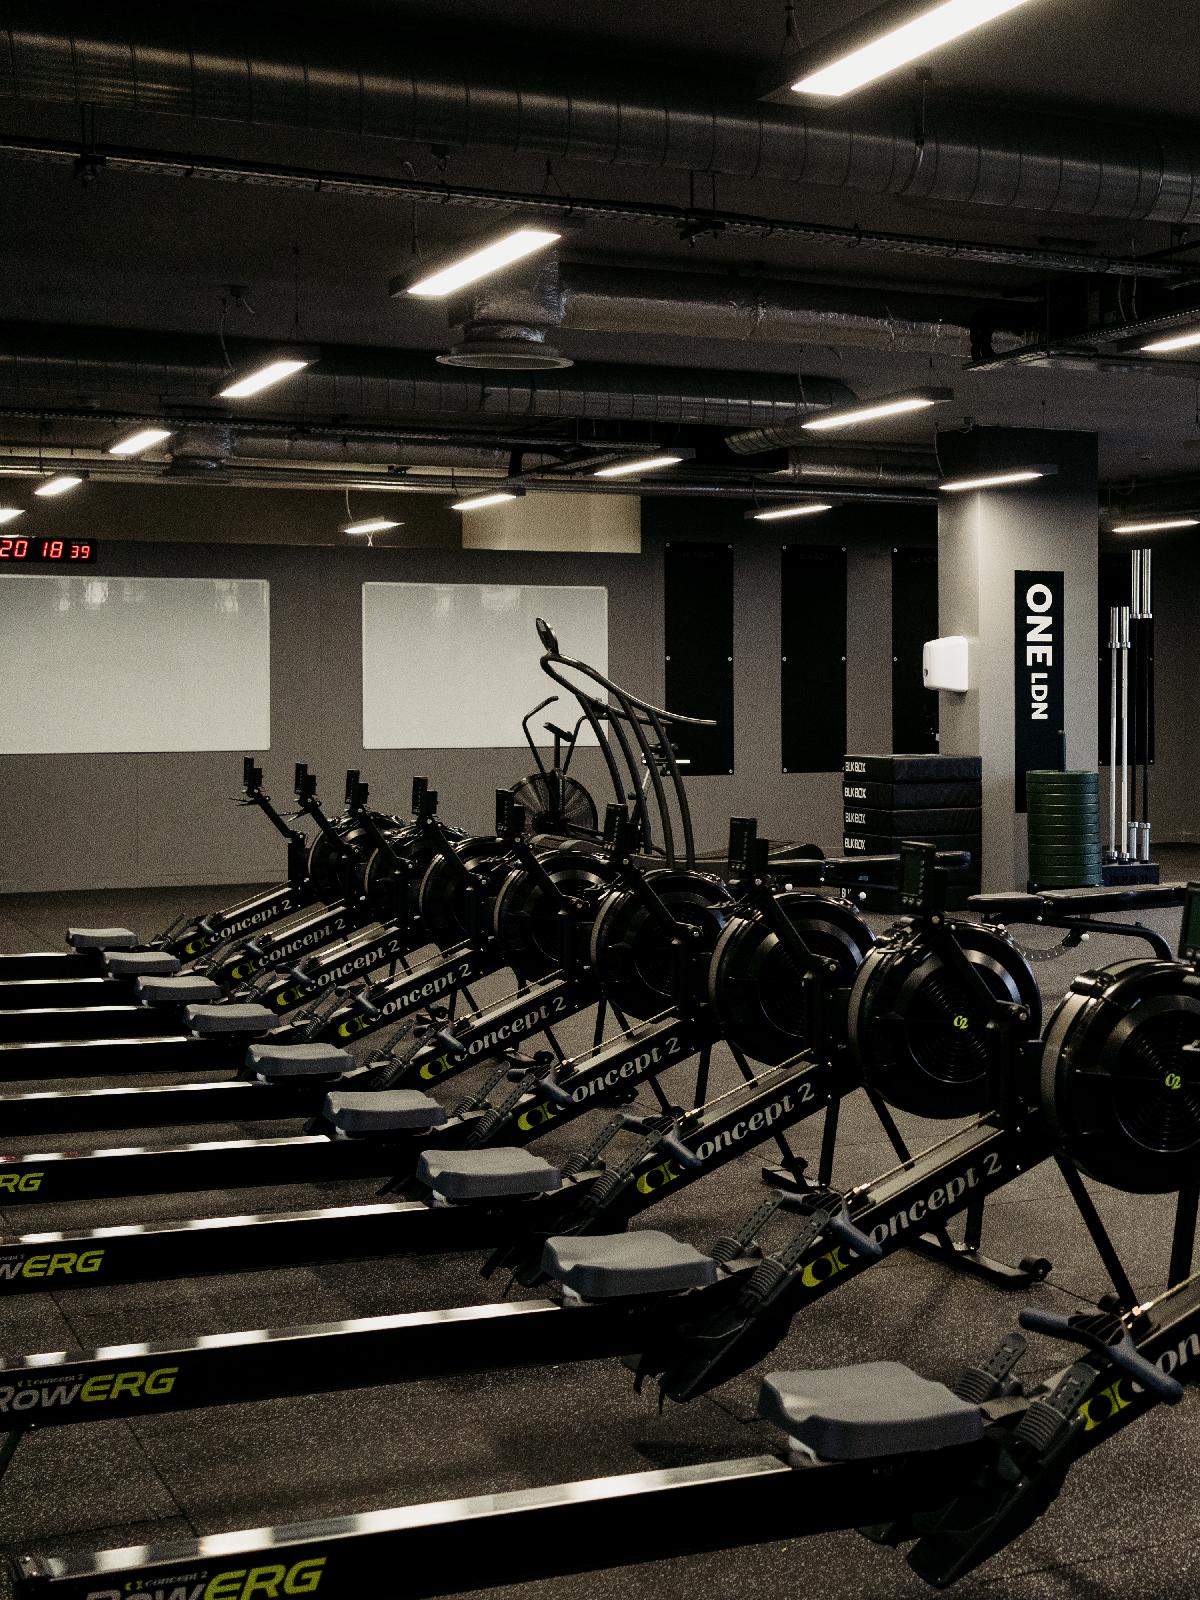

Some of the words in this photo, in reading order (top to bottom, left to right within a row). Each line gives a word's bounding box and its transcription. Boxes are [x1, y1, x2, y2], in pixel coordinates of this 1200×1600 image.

[0, 540, 28, 557] 20
[42, 541, 64, 558] 18
[70, 545, 91, 559] 39
[1026, 583, 1053, 667] ONE
[1031, 672, 1048, 720] LDN
[209, 907, 280, 944] concept
[387, 939, 401, 953] 2
[258, 926, 332, 968] concept
[458, 963, 472, 978] 2
[552, 996, 567, 1012] 2
[556, 1047, 663, 1111] oncept
[665, 1036, 681, 1055] 2
[679, 1095, 795, 1170] oncept
[797, 1082, 815, 1103] 2
[849, 1167, 980, 1258] oncept
[983, 1152, 1002, 1176] 2
